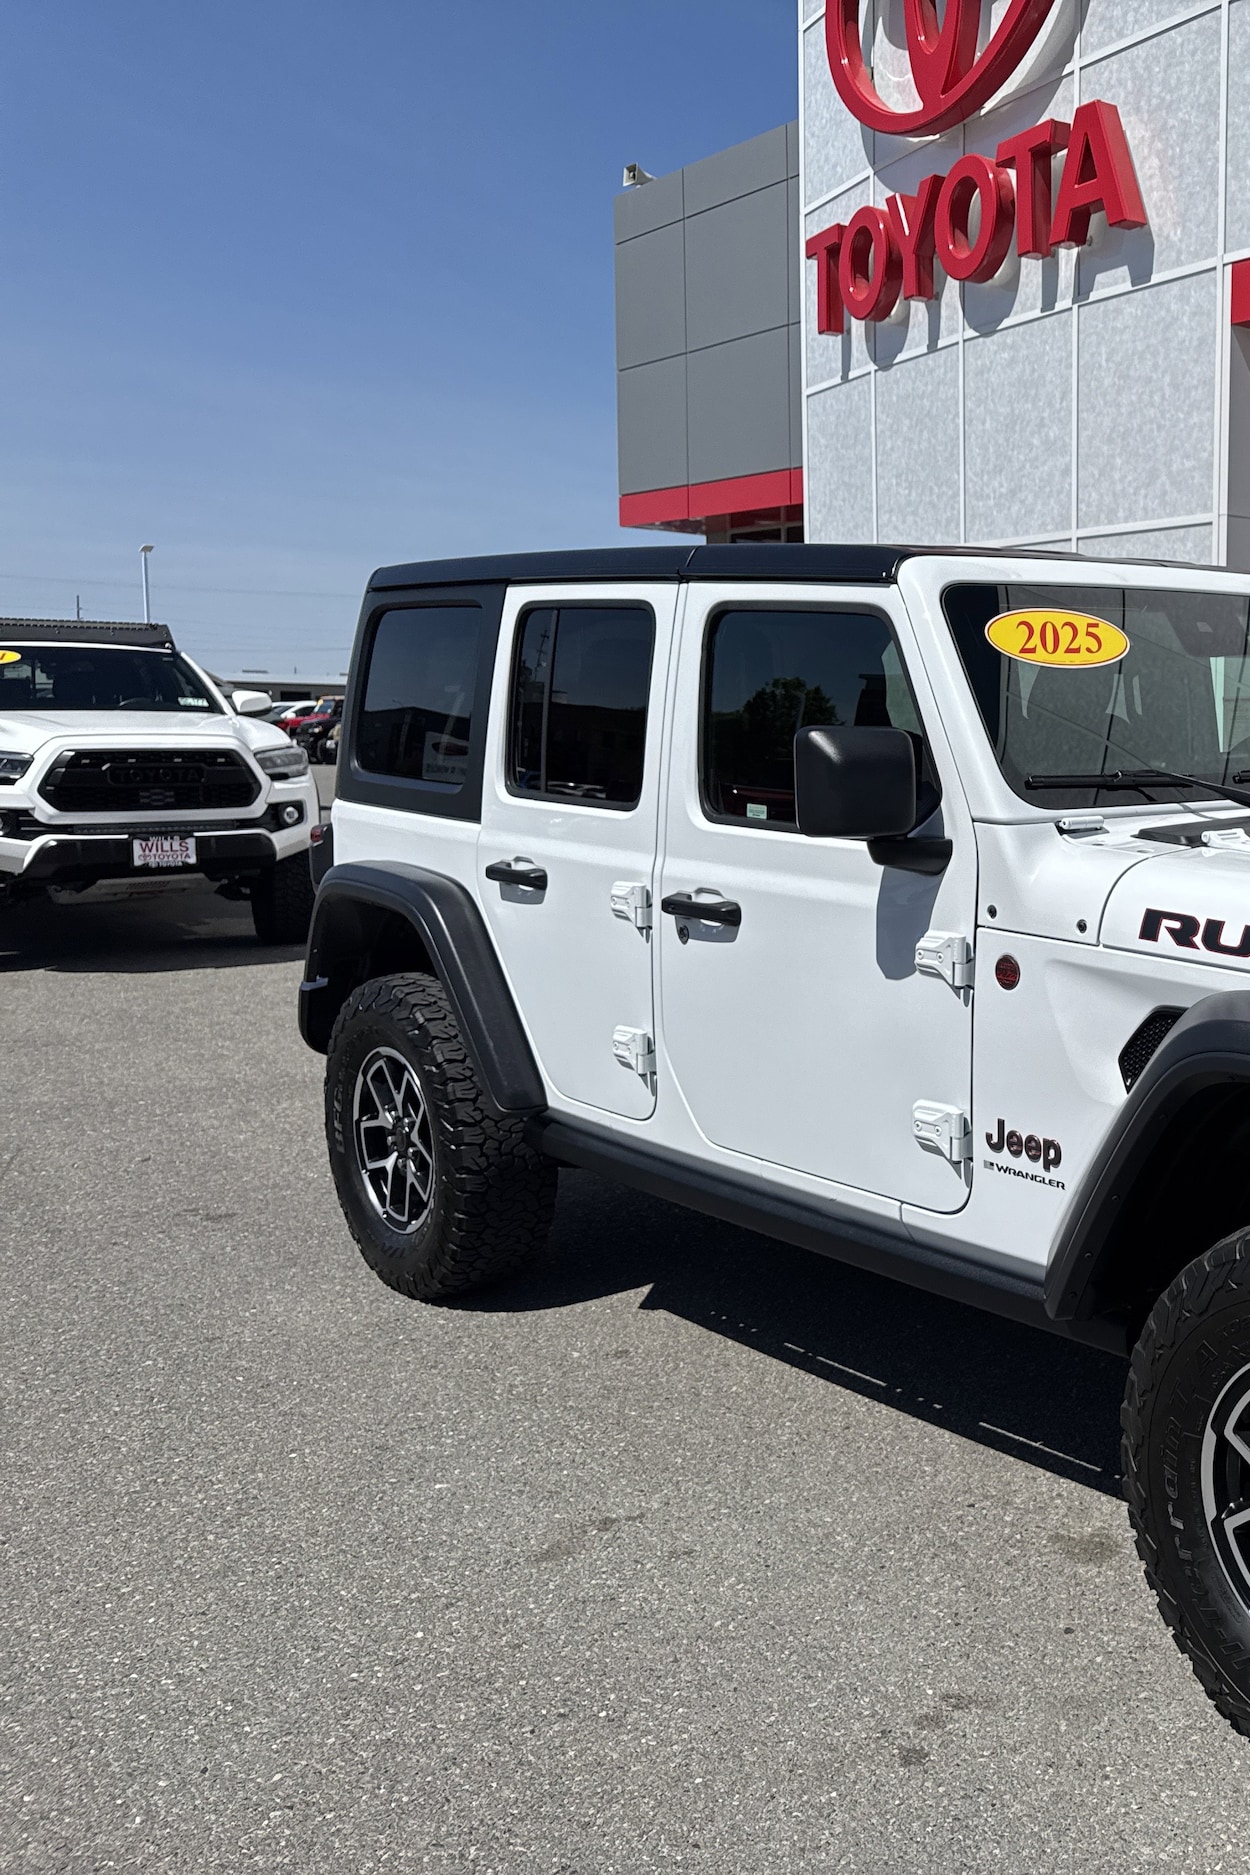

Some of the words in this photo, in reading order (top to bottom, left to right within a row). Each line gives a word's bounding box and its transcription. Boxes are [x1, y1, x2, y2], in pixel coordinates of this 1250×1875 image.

[806, 99, 1147, 336] TOYOTA
[1016, 620, 1103, 655] 2025
[139, 840, 190, 853] WILLS
[152, 852, 192, 861] TOYOTA
[985, 1117, 1063, 1173] Jeep
[995, 1162, 1066, 1191] WRANGLER
